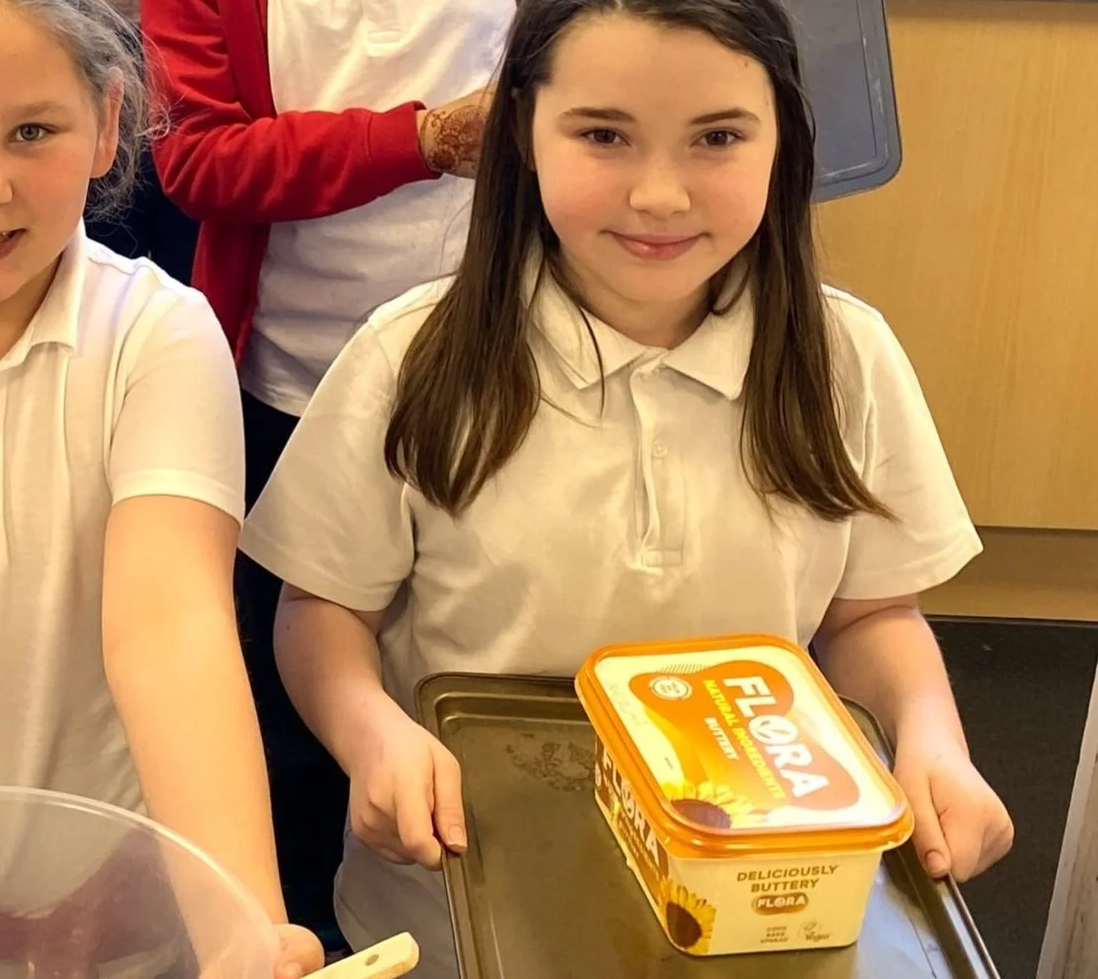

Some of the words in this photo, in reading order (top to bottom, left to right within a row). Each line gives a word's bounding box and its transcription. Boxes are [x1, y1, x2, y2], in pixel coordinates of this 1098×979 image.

[702, 679, 740, 727] NATURAL
[722, 676, 830, 798] FLORA
[737, 865, 839, 881] DELICIOUSLY
[751, 878, 820, 893] BUTTERY
[757, 896, 806, 909] FLORA
